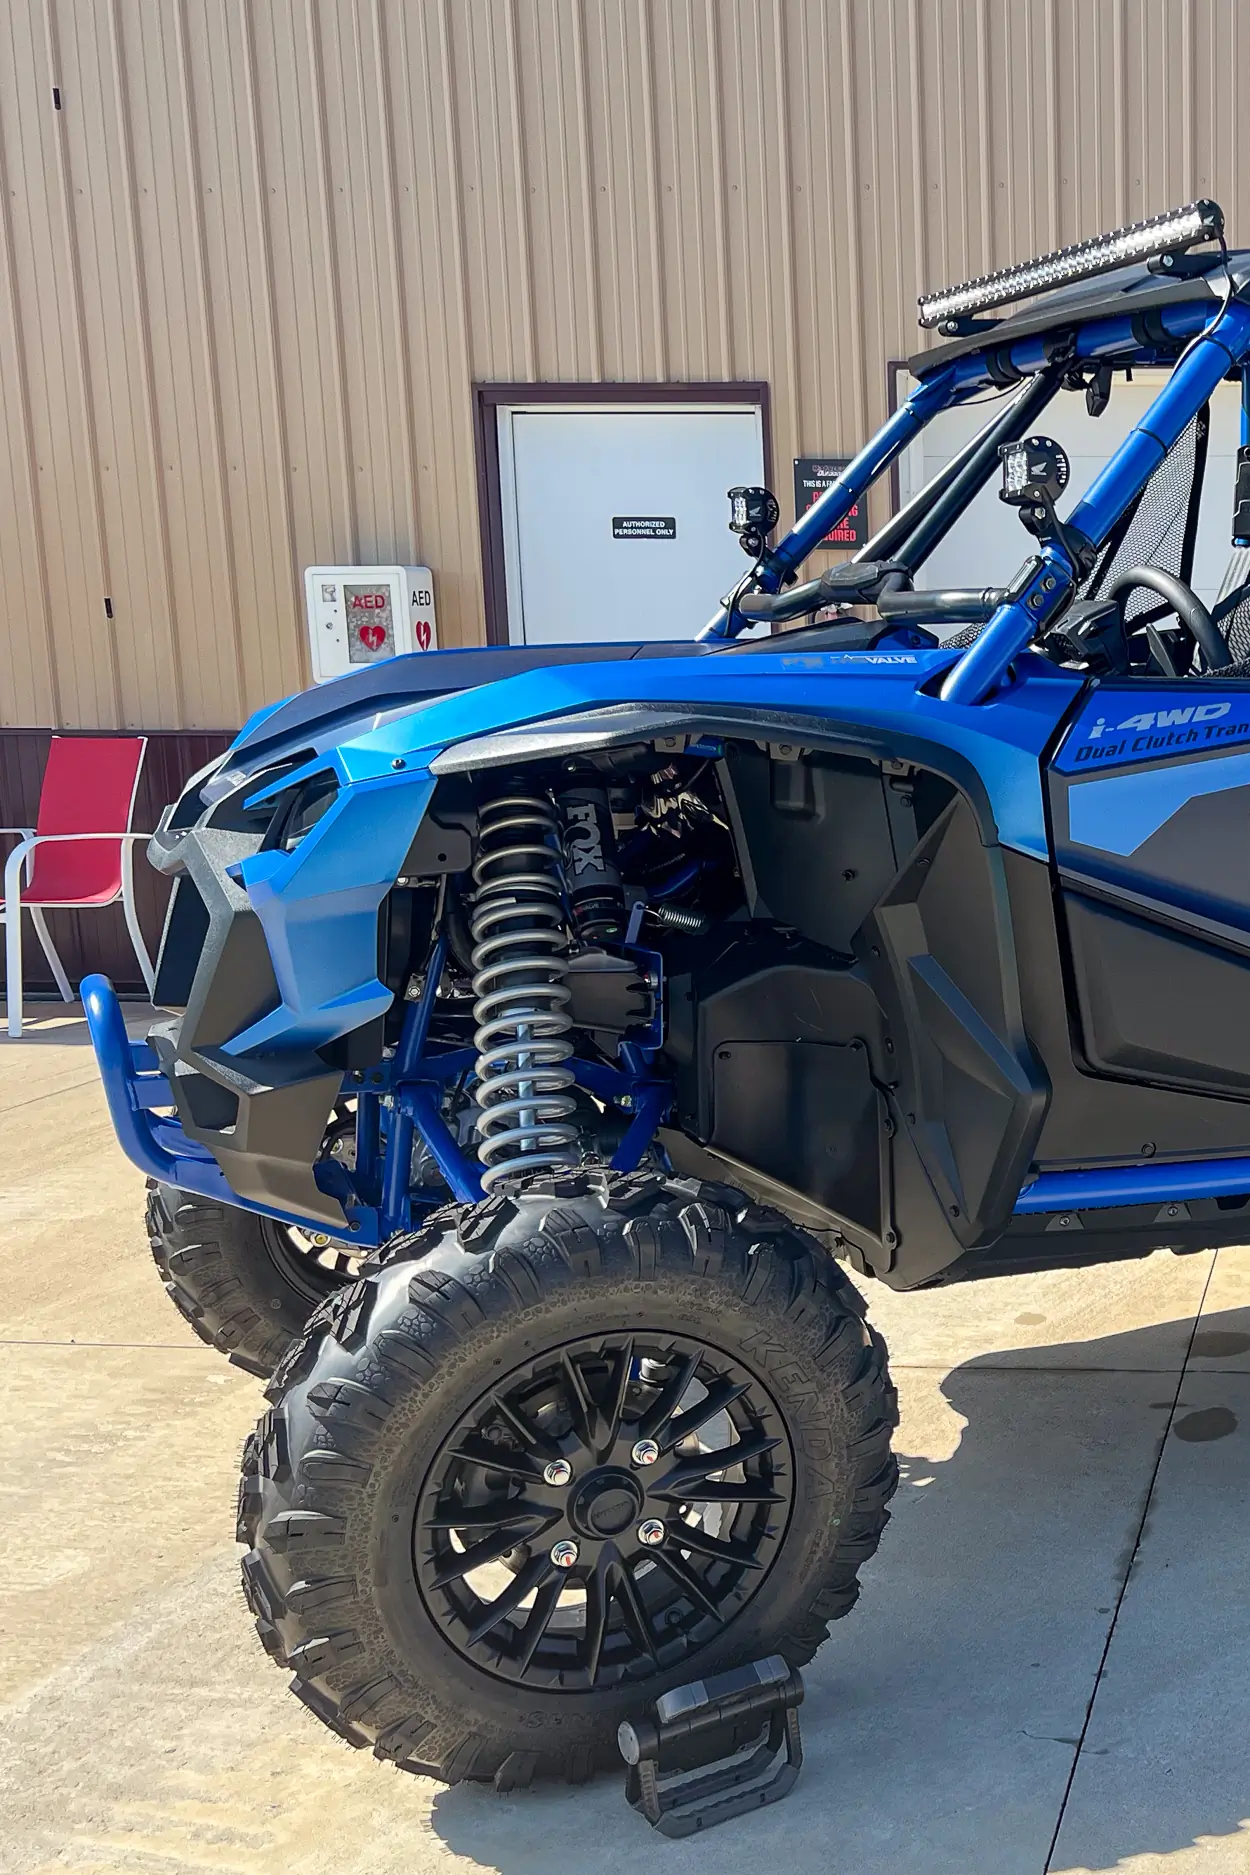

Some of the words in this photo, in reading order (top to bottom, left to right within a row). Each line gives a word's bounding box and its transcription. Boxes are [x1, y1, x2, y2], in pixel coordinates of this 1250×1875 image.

[803, 480, 815, 488] THIS
[816, 480, 821, 488] IS
[352, 595, 386, 609] AED
[411, 590, 431, 606] AED
[865, 656, 918, 664] VALVE
[1088, 702, 1232, 739] i-4WD
[1074, 740, 1124, 763] Dual
[1131, 729, 1199, 752] Clutch
[563, 803, 606, 876] FOX
[738, 1329, 837, 1501] KENDA
